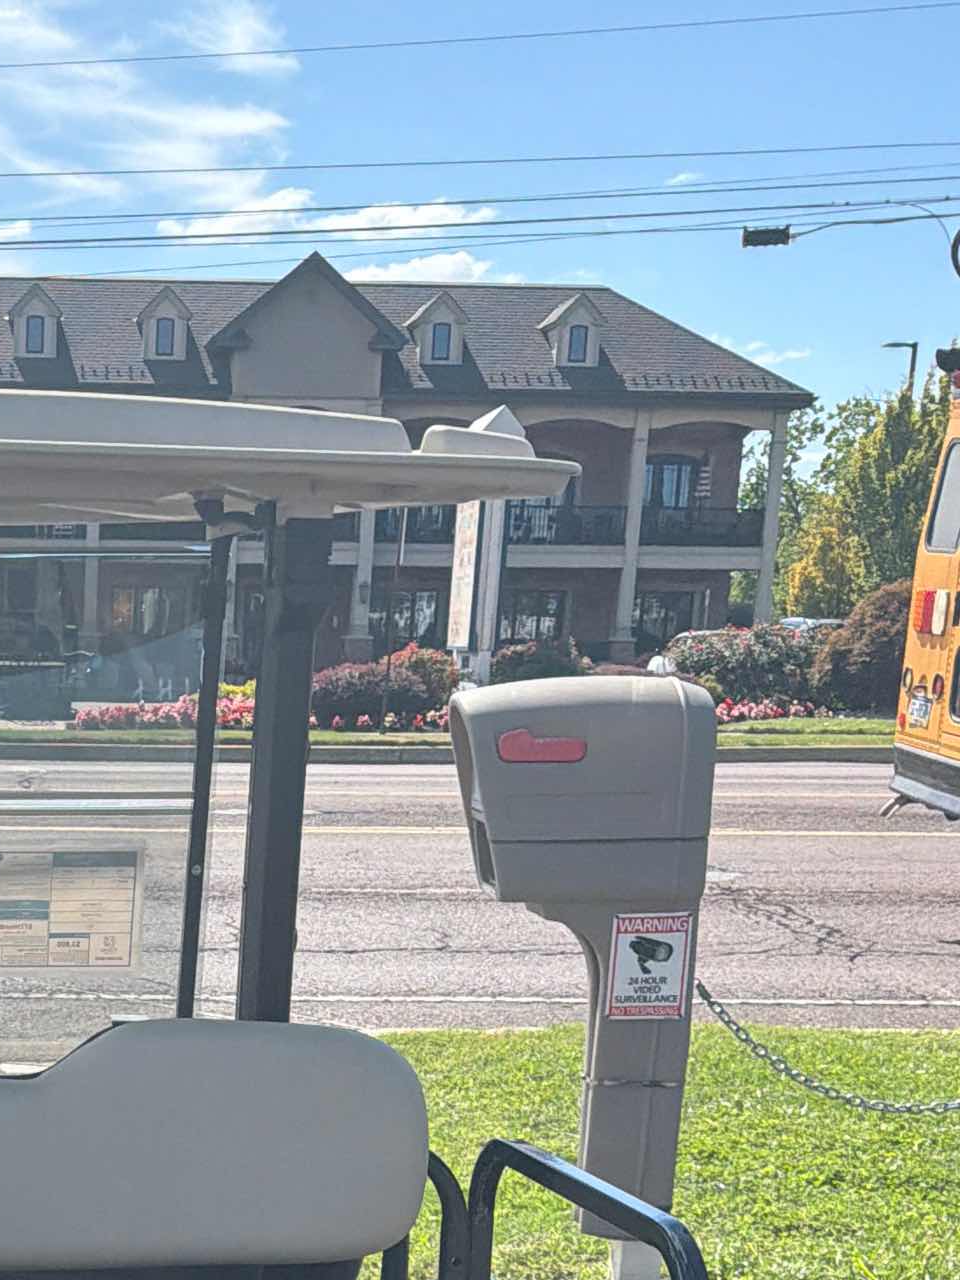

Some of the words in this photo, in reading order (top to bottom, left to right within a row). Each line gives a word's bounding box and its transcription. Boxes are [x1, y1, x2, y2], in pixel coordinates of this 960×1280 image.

[619, 917, 688, 932] WARNING
[628, 977, 639, 986] 24
[641, 976, 668, 985] HOUR
[633, 985, 661, 994] VIDEO
[611, 1007, 625, 1015] NO
[626, 1006, 680, 1015] TRESPASSING
